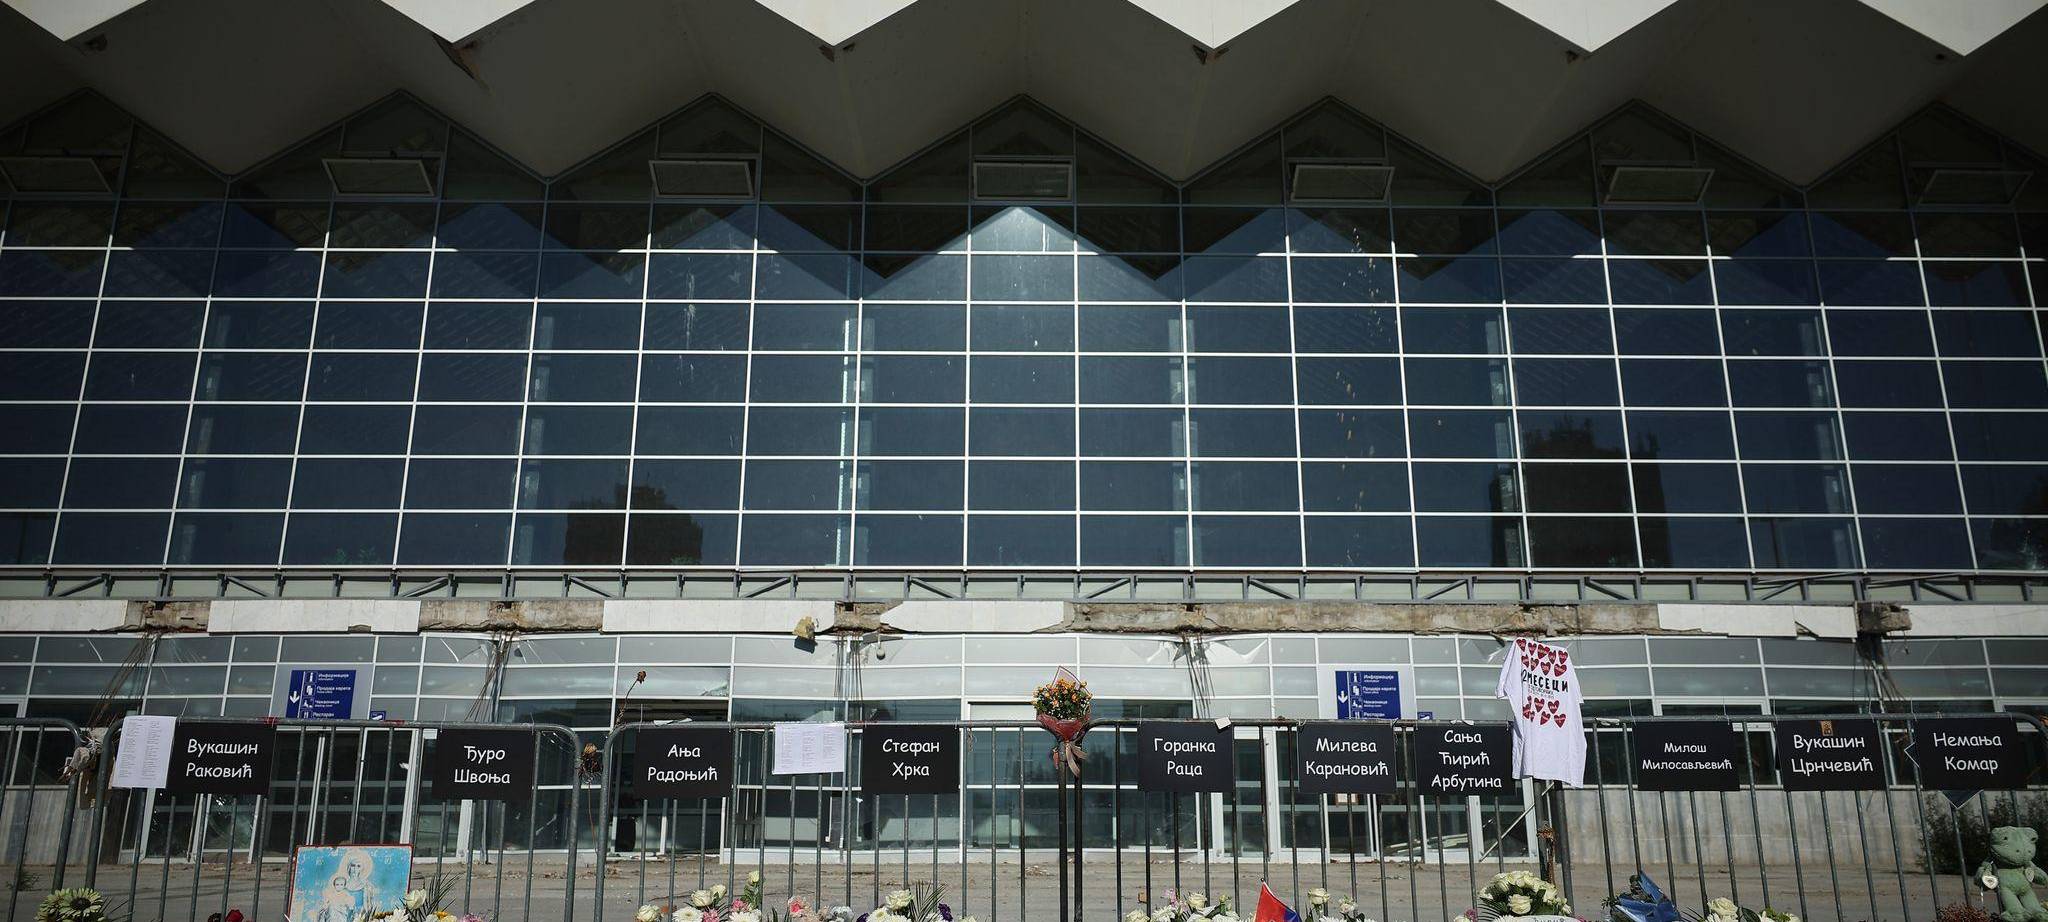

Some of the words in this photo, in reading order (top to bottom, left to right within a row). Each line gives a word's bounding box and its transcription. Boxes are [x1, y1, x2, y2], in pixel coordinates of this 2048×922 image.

[1527, 671, 1569, 693] МЕСЕЦИ
[1315, 737, 1378, 753] Милева
[1443, 729, 1483, 745] Сања
[1793, 733, 1866, 753] Вукашин
[1932, 731, 2003, 748] Немања
[187, 738, 258, 762] Вукашин
[463, 745, 506, 764] Ђуро
[667, 744, 702, 758] Ања
[882, 738, 940, 757] Стефан
[1154, 738, 1216, 757] Горанка
[1663, 741, 1707, 753] Милош
[1166, 760, 1203, 777] Раца
[1305, 759, 1389, 777] Карановић
[1438, 751, 1491, 770] Ћирић
[1642, 758, 1733, 770] Милосављевић
[1791, 757, 1874, 776] Црнчевић
[1944, 756, 1999, 774] Комар
[185, 762, 252, 779] Раковић
[453, 768, 511, 784] Швоња
[647, 766, 718, 783] Радоњић
[891, 761, 930, 781] Хрка
[1431, 773, 1503, 792] Арбутина
